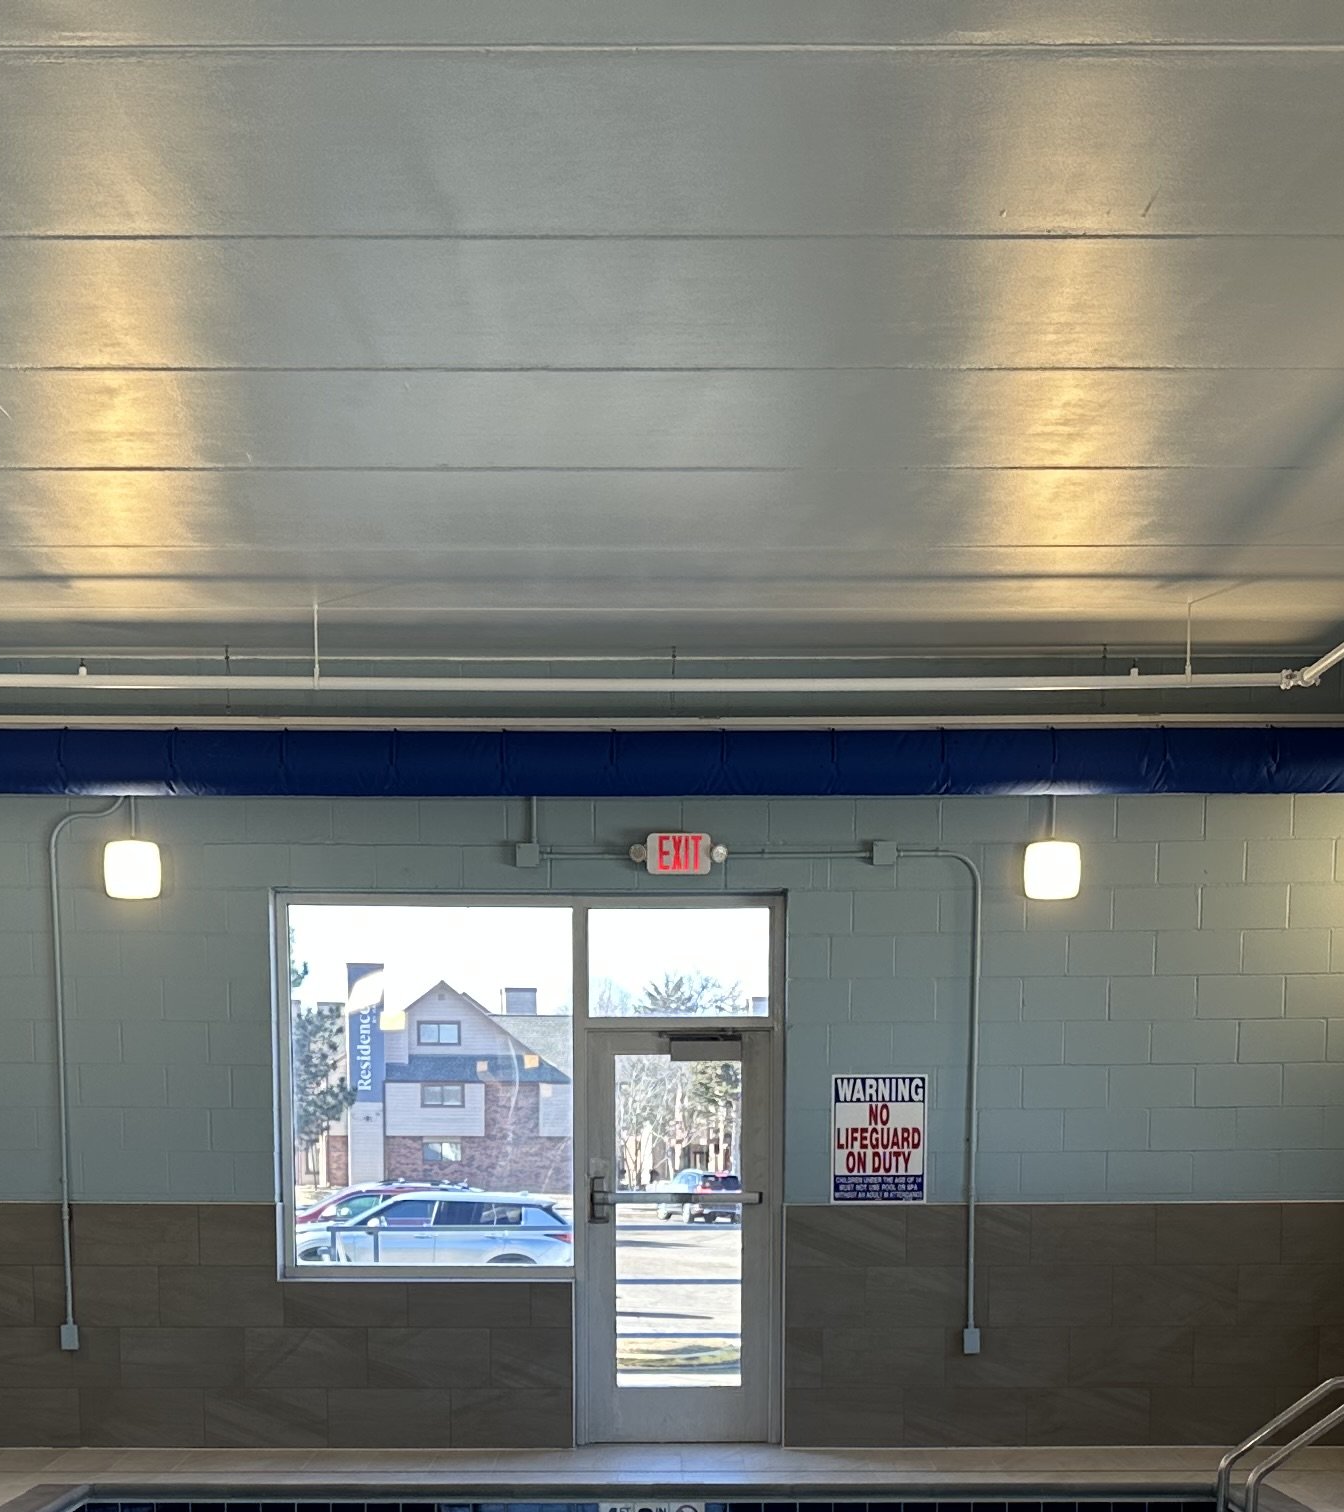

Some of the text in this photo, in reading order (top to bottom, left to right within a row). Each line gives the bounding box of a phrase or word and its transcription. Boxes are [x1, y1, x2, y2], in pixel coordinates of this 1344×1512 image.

[657, 835, 702, 870] EXIT
[837, 1078, 924, 1102] WARNING
[868, 1104, 890, 1126] NO
[837, 1128, 921, 1150] LIFEGUARD
[846, 1151, 911, 1173] ON DUTY
